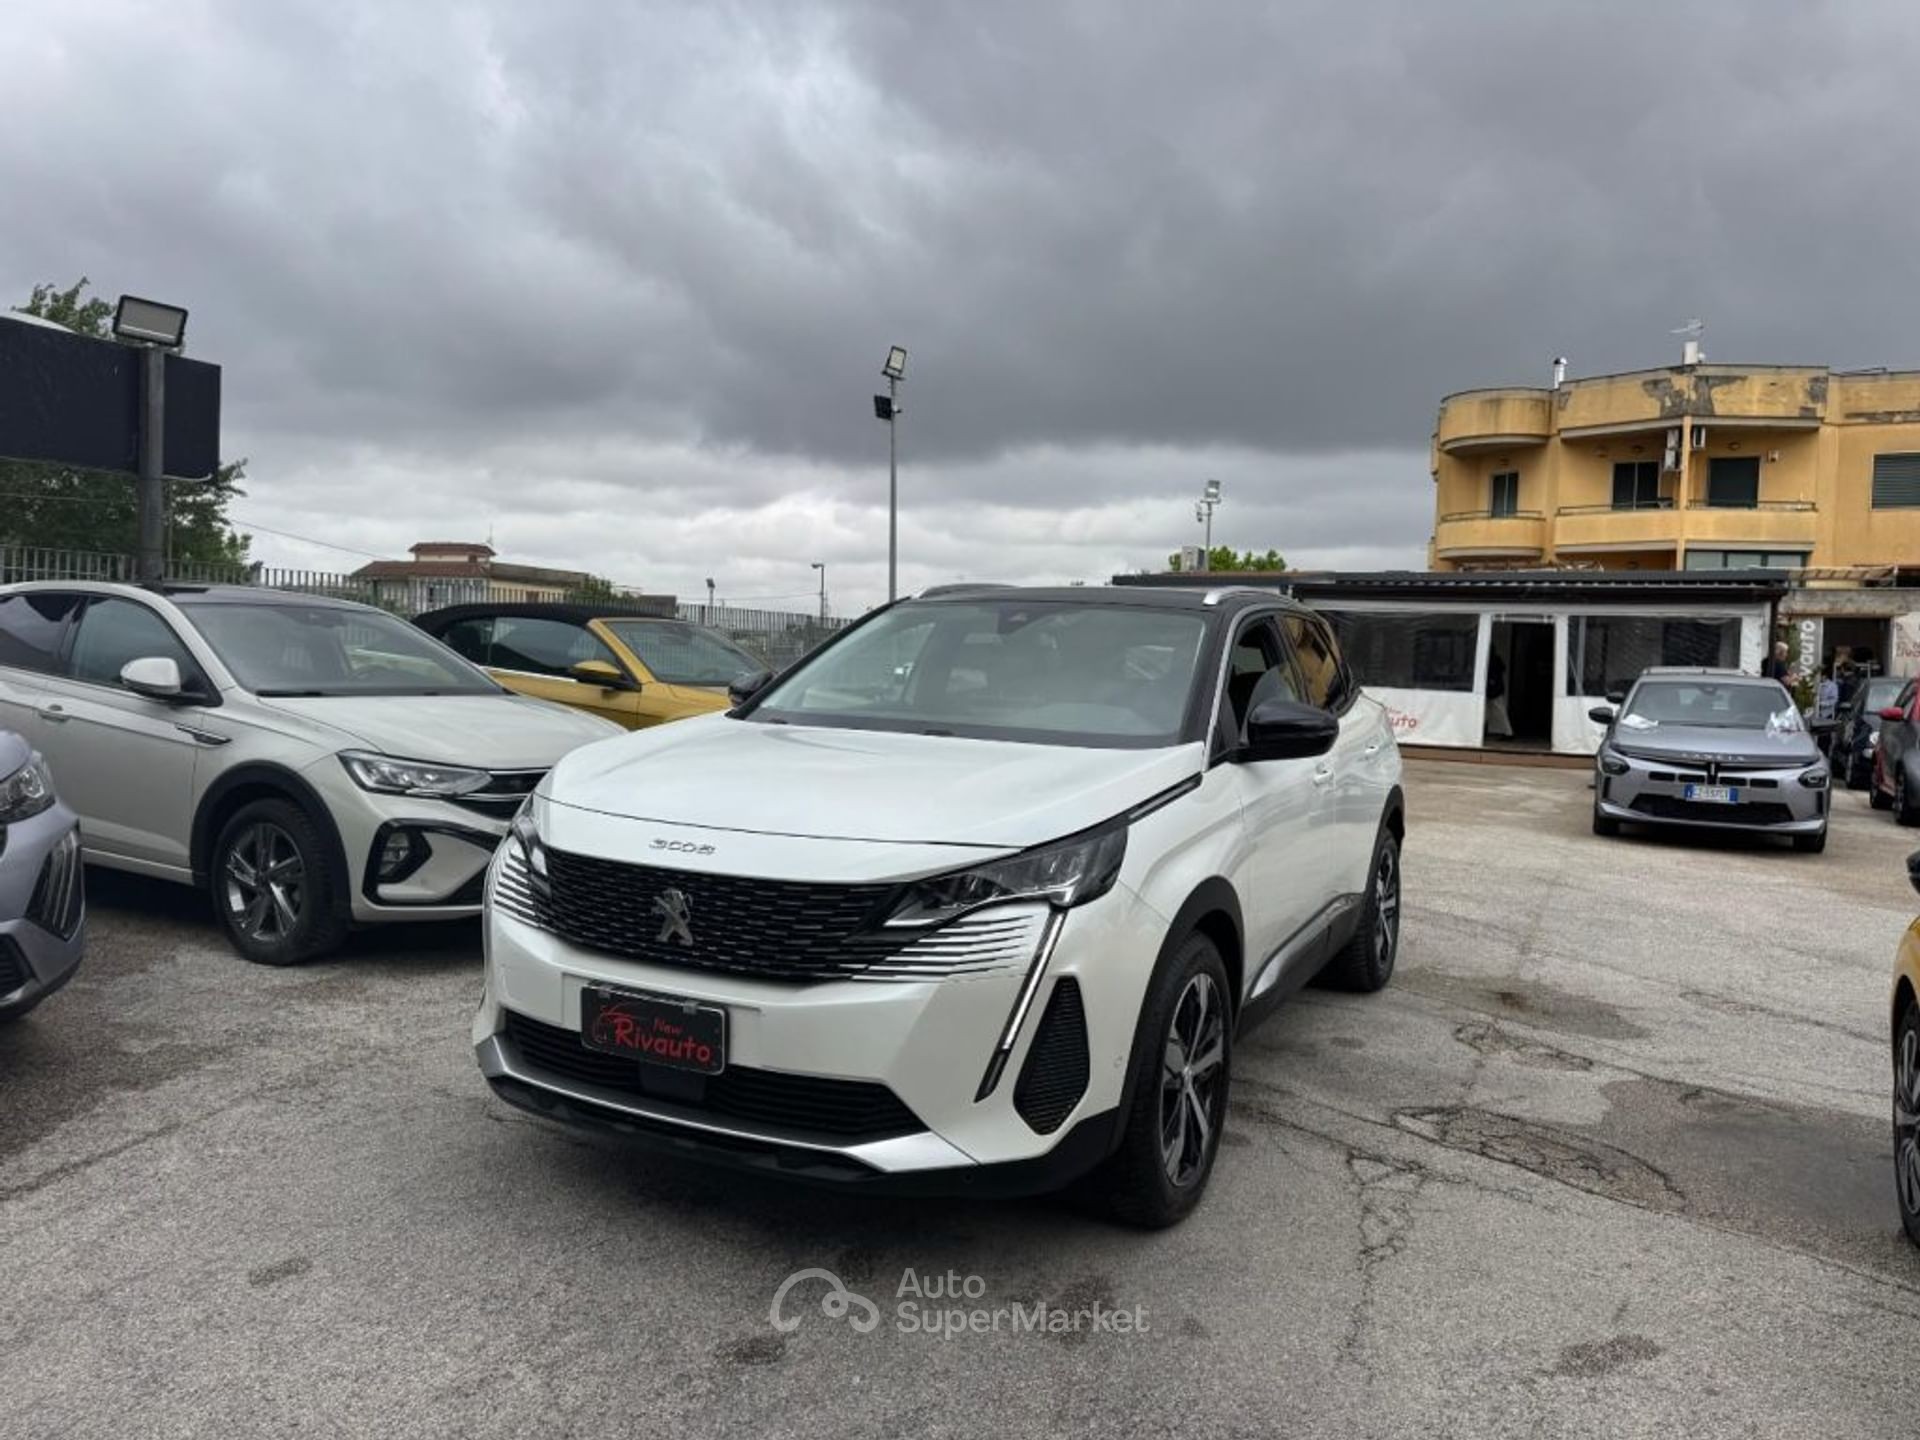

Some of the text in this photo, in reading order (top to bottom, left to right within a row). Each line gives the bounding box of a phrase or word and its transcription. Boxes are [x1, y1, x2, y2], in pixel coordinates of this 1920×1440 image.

[649, 839, 716, 854] 3008
[654, 1016, 684, 1034] New
[614, 1017, 711, 1062] Rivauto
